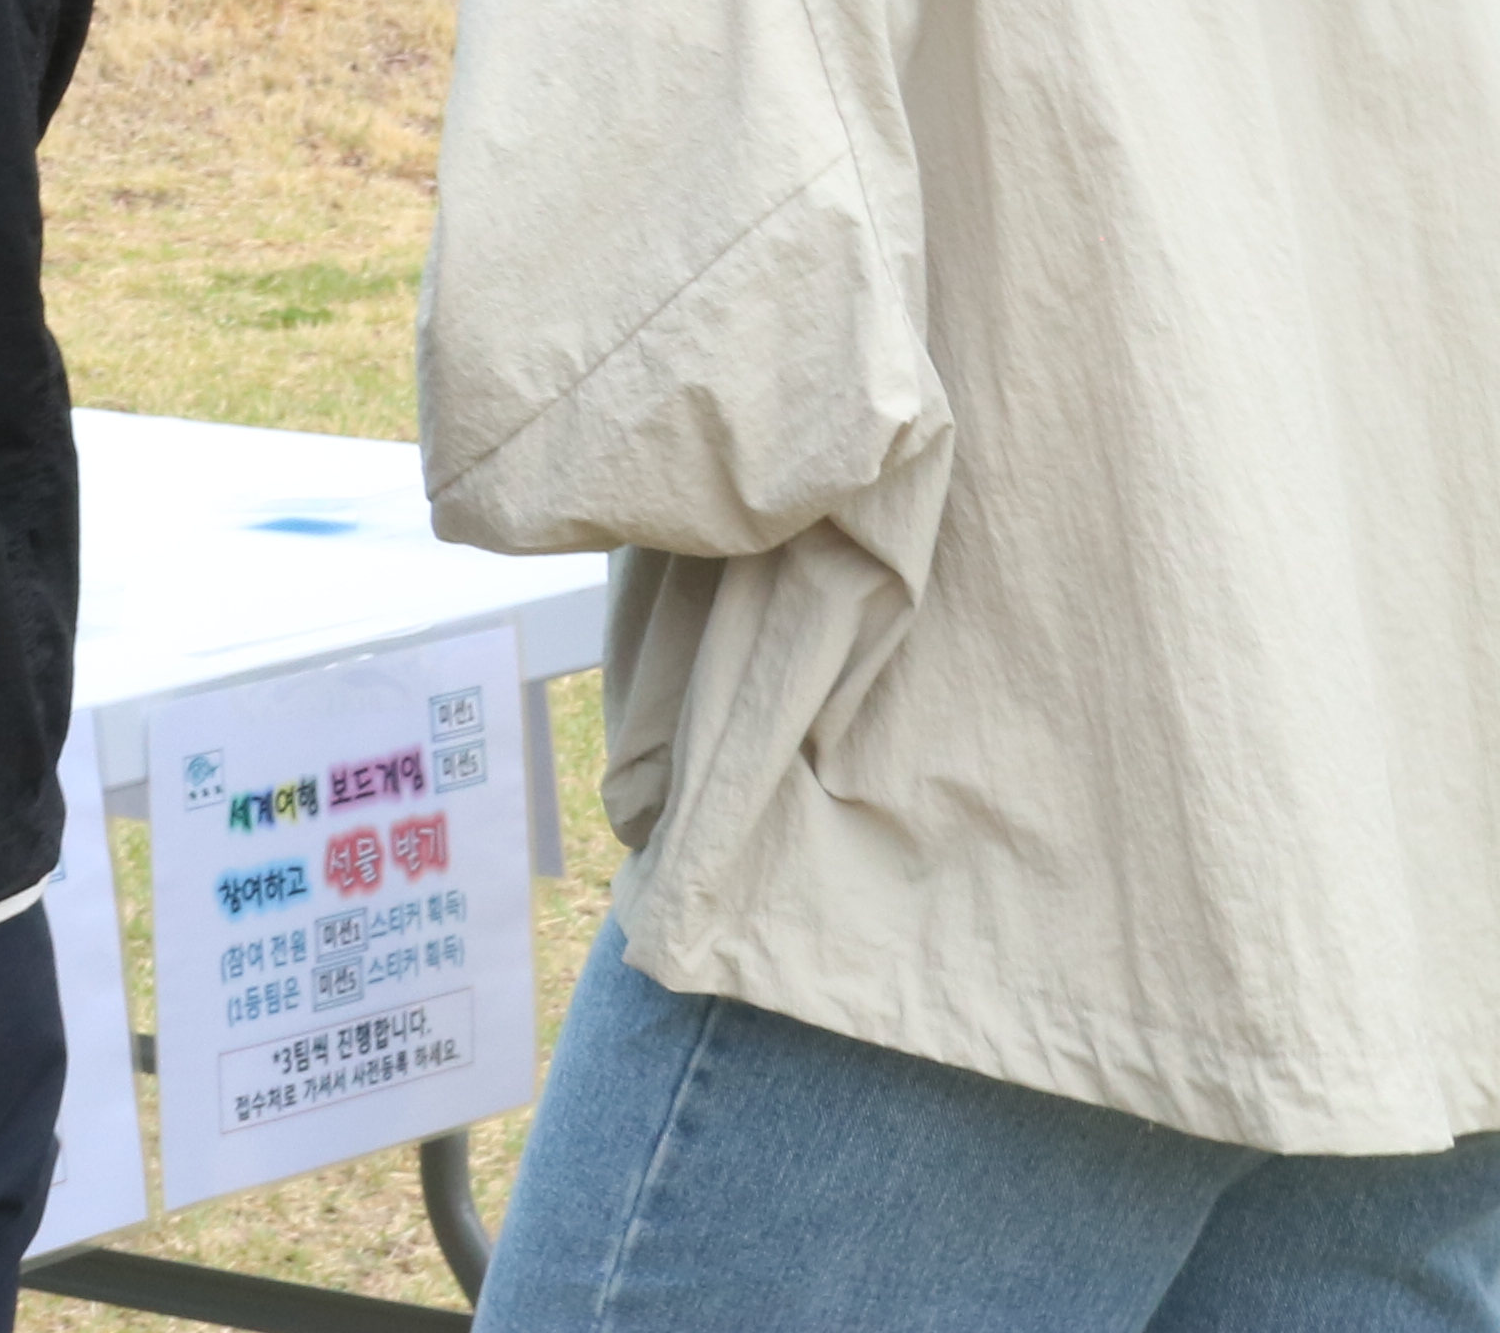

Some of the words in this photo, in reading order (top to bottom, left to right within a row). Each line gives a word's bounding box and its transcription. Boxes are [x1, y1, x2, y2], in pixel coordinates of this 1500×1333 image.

[437, 700, 476, 728] 미션1
[229, 774, 319, 831] 세계여행
[329, 751, 426, 806] 보드게임
[441, 751, 479, 780] 미션5
[327, 834, 380, 888] 선물
[392, 824, 448, 873] 받기
[221, 943, 266, 984] (참여
[270, 929, 307, 968] 전원
[322, 919, 361, 949] 미션1
[370, 900, 422, 938] 스티커
[428, 890, 467, 927] 획득)
[228, 983, 301, 1028] (1등팀은
[319, 970, 357, 1000] 미션5
[368, 947, 420, 985] 스티커
[427, 935, 466, 974] 획득)
[336, 1010, 431, 1060] 진행합니다.
[235, 1081, 298, 1122] 접수처로
[303, 1067, 347, 1102] 가셔서
[351, 1053, 409, 1091] 사전등록
[415, 1038, 460, 1074] 하세요.
